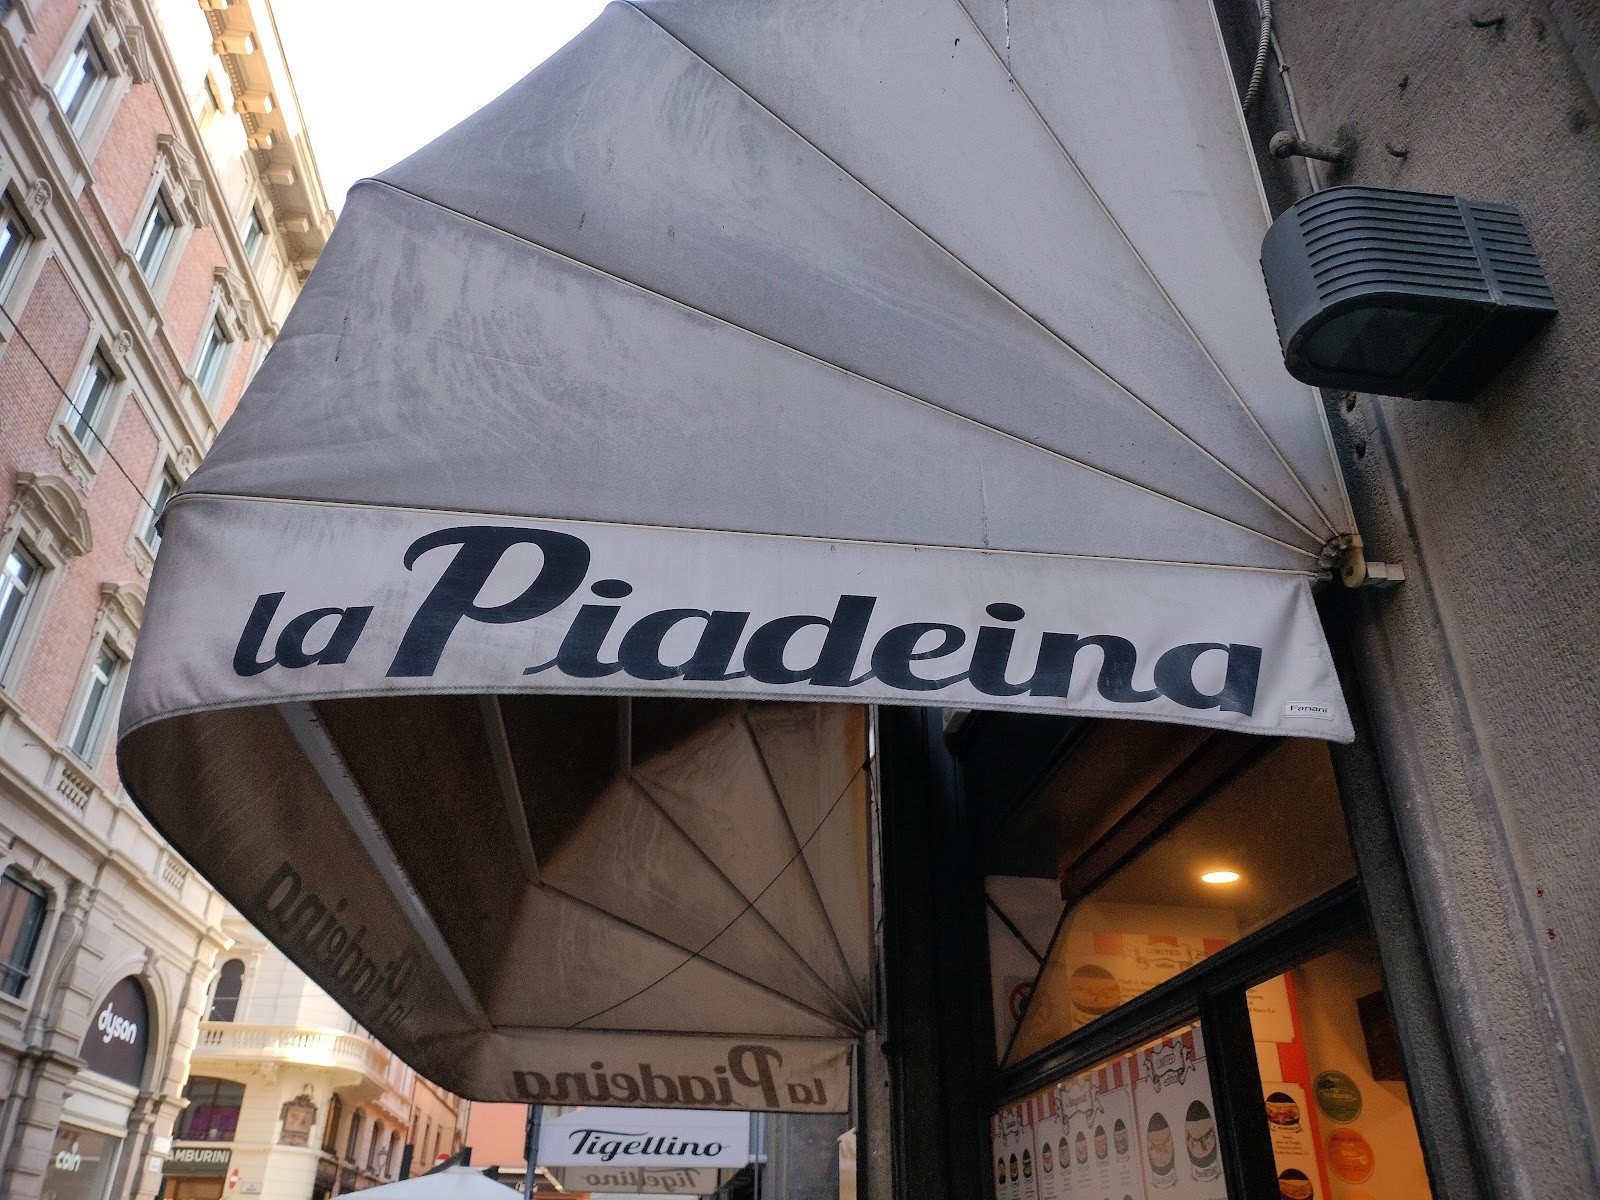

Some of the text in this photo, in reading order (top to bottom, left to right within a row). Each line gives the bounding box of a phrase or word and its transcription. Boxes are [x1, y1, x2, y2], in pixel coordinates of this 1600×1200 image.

[233, 526, 1262, 717] la Piadeina
[97, 1002, 137, 1044] dyson
[55, 1142, 81, 1172] coin
[569, 1128, 730, 1162] Tigellino
